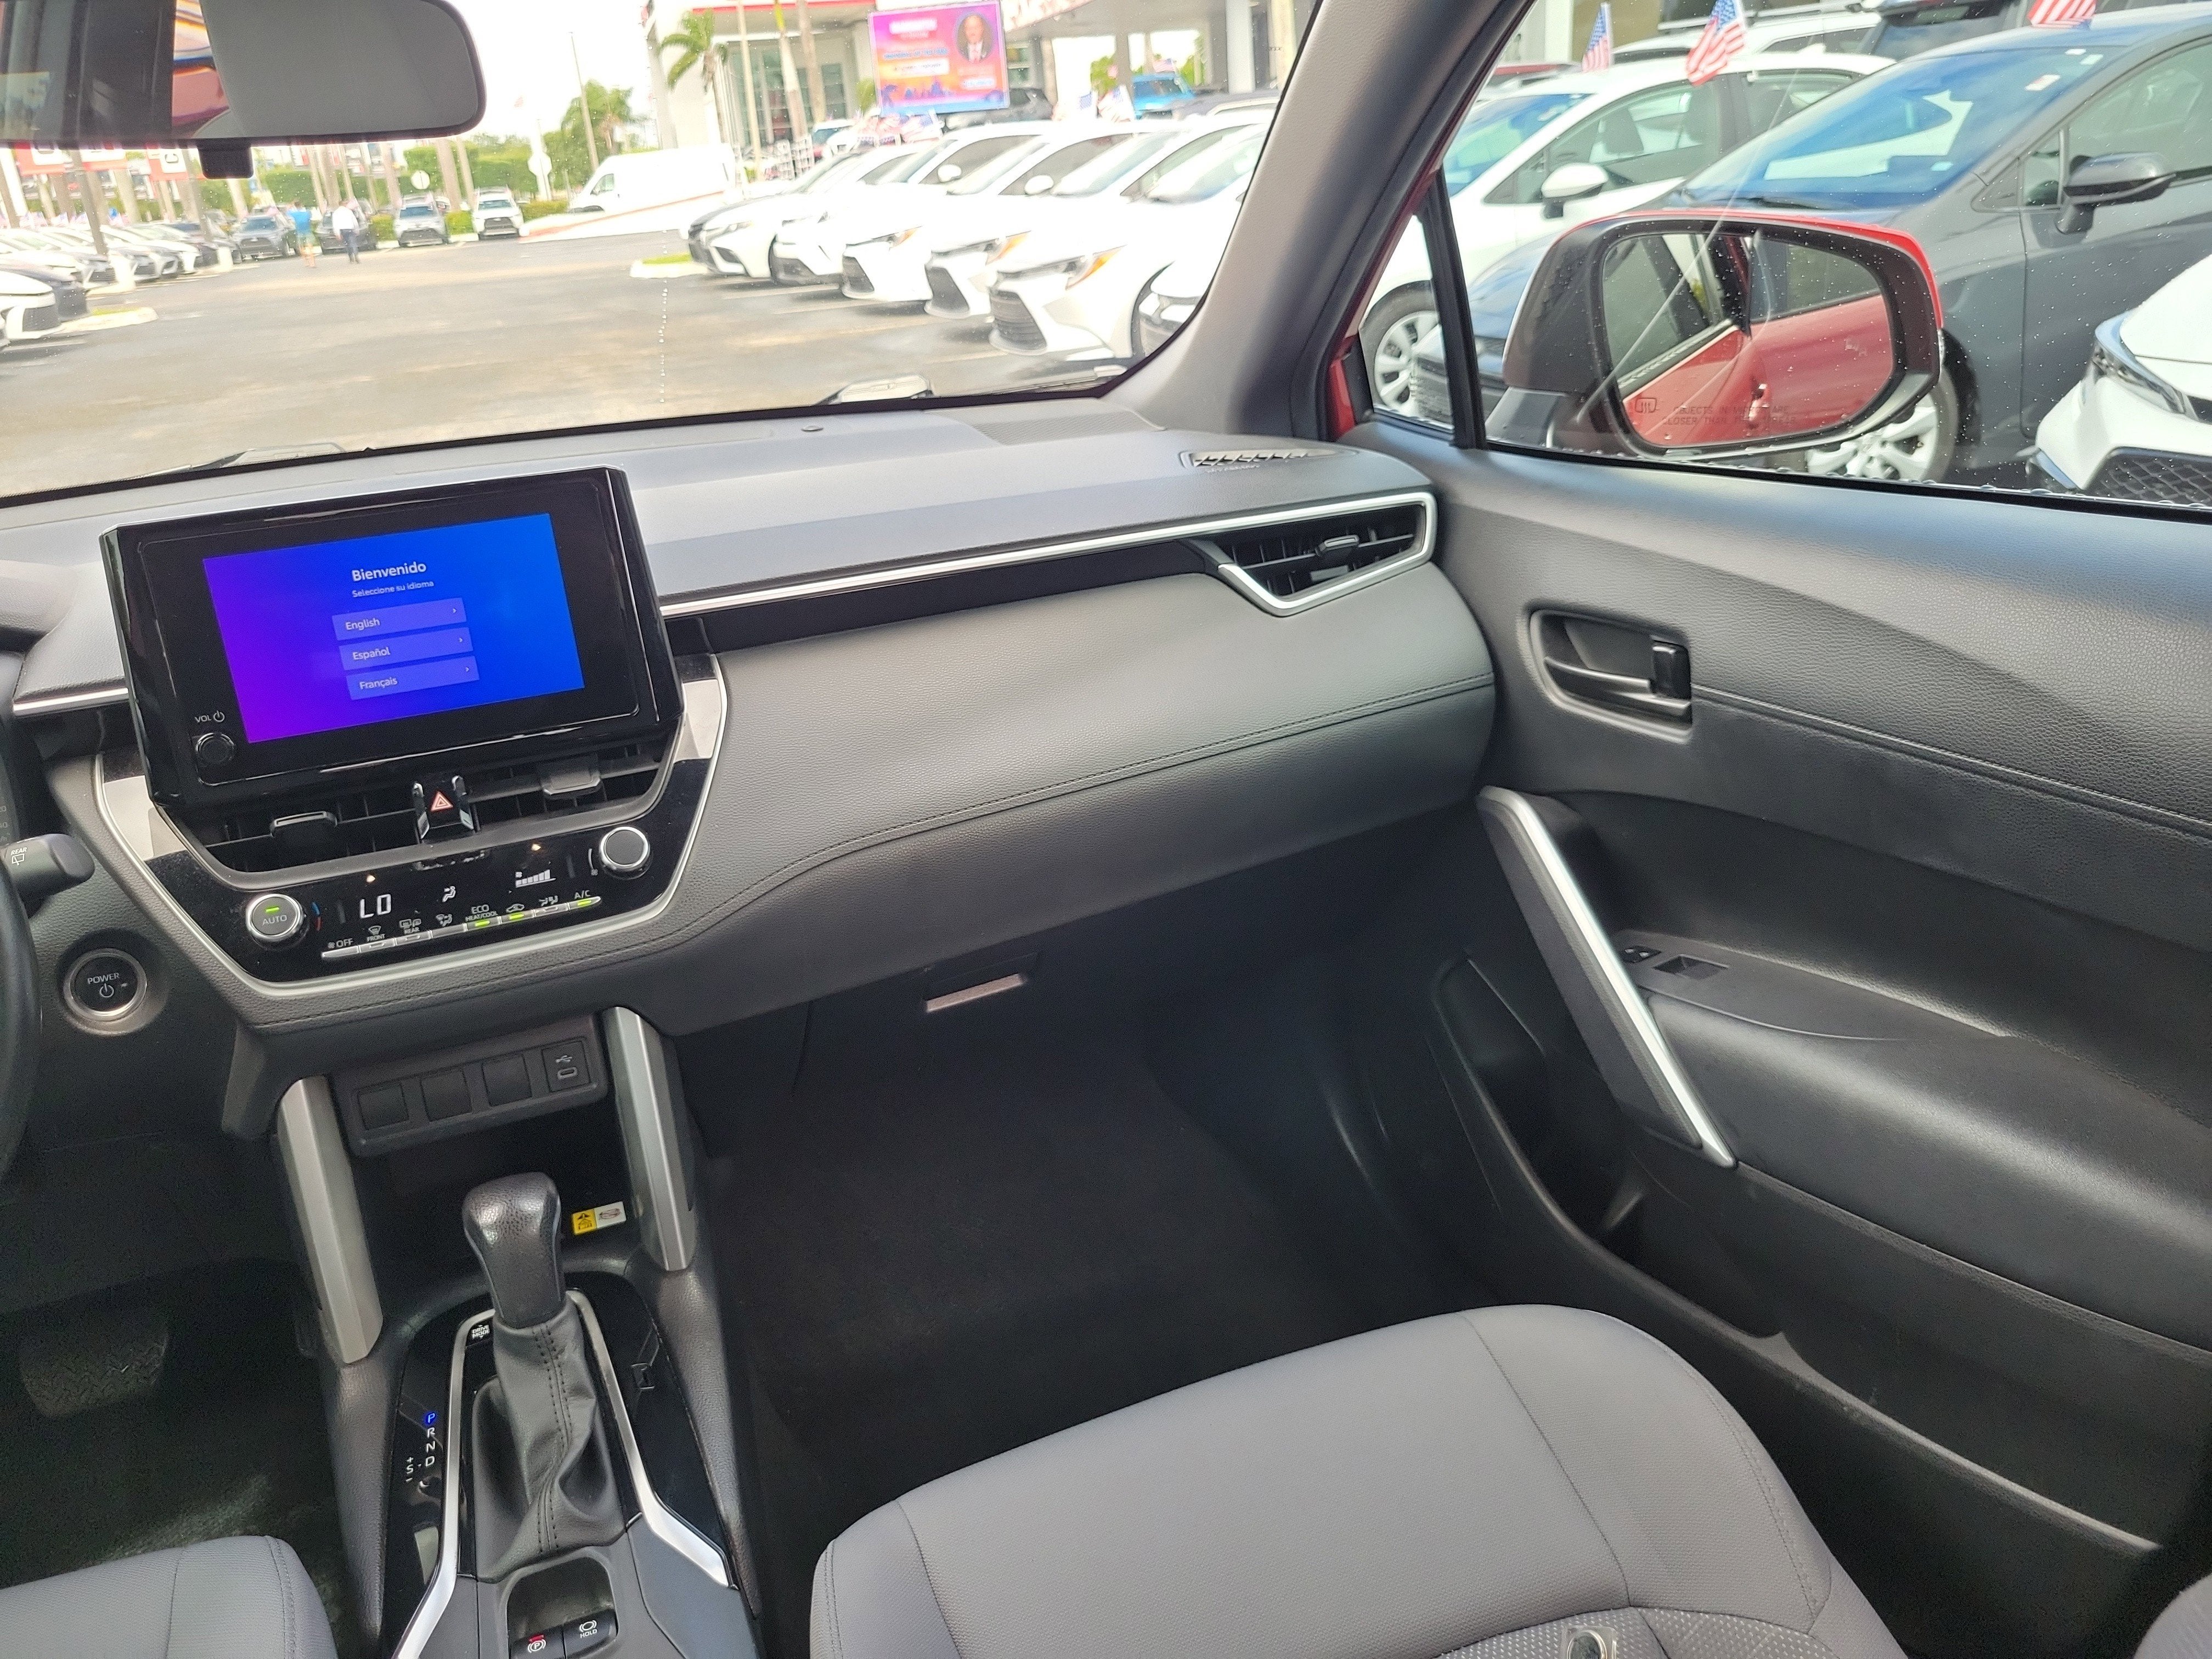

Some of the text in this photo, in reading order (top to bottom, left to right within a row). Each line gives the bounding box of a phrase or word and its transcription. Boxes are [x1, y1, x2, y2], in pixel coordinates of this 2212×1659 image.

[351, 561, 427, 582] Bienvenido
[352, 585, 395, 597] Seleccione
[407, 580, 435, 590] idioma
[345, 618, 380, 631] English
[352, 647, 391, 661] Español
[359, 677, 398, 690] Français
[11, 847, 27, 855] REAR
[574, 889, 591, 899] A/C
[359, 894, 391, 919] LO
[471, 904, 489, 914] ECO
[262, 915, 287, 926] AUTO
[465, 911, 498, 922] HEAT/COOL
[336, 938, 353, 947] OFF
[366, 933, 385, 942] FRONT
[88, 973, 120, 984] POWER
[427, 1413, 436, 1424] P
[427, 1427, 436, 1438] R
[426, 1441, 436, 1453] N
[425, 1455, 435, 1468] D
[580, 1628, 597, 1639] HOLD
